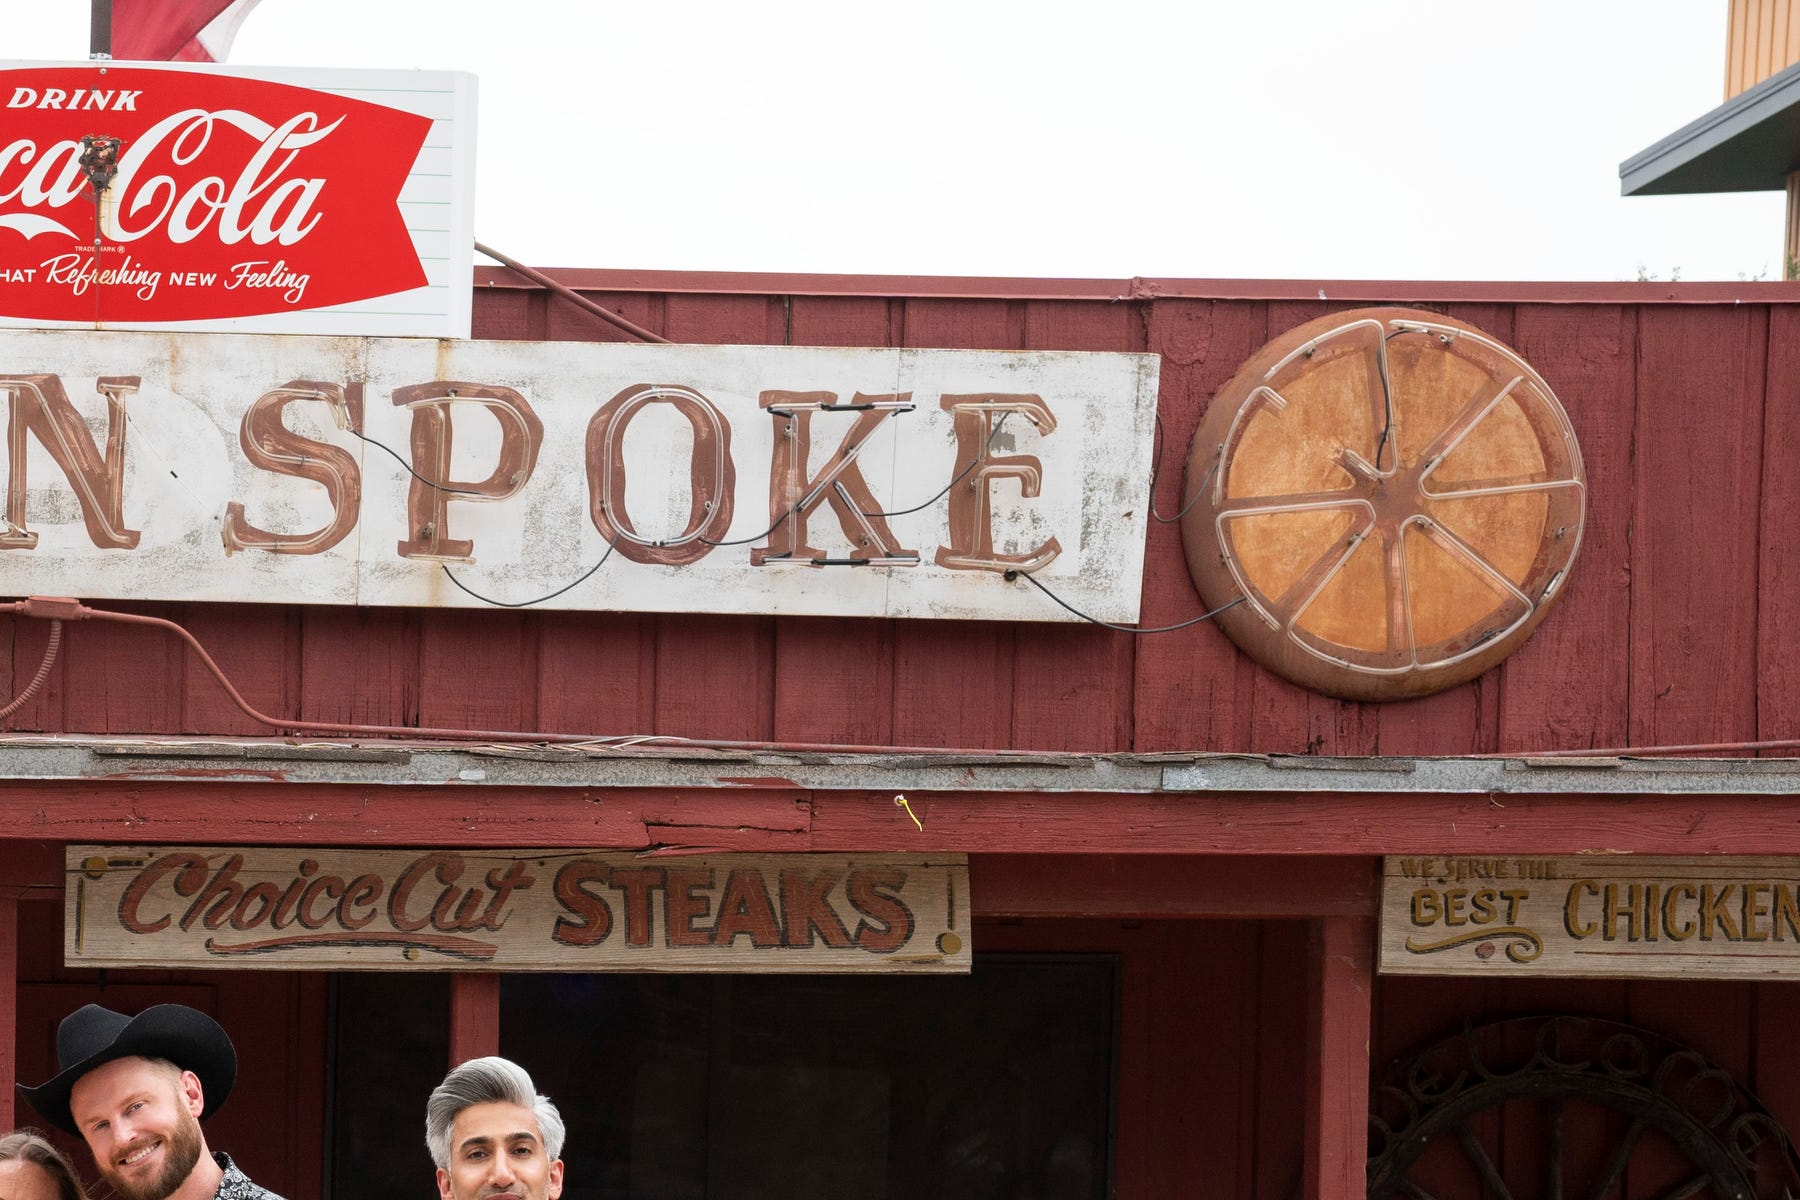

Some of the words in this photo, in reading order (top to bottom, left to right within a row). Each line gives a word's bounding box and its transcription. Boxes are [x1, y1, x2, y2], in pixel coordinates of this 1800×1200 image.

[6, 86, 143, 112] DRINK
[40, 253, 161, 301] Refreshing
[169, 271, 217, 287] NEW
[224, 260, 310, 304] Feeling
[224, 379, 1062, 572] SPOKE
[1400, 857, 1434, 879] WE
[1446, 858, 1509, 881] SERVE
[118, 850, 380, 936] Choice
[387, 851, 534, 934] Cut
[552, 860, 916, 955] STEAKS
[1410, 888, 1529, 927] BEST
[1563, 879, 1800, 944] CHICKEN
